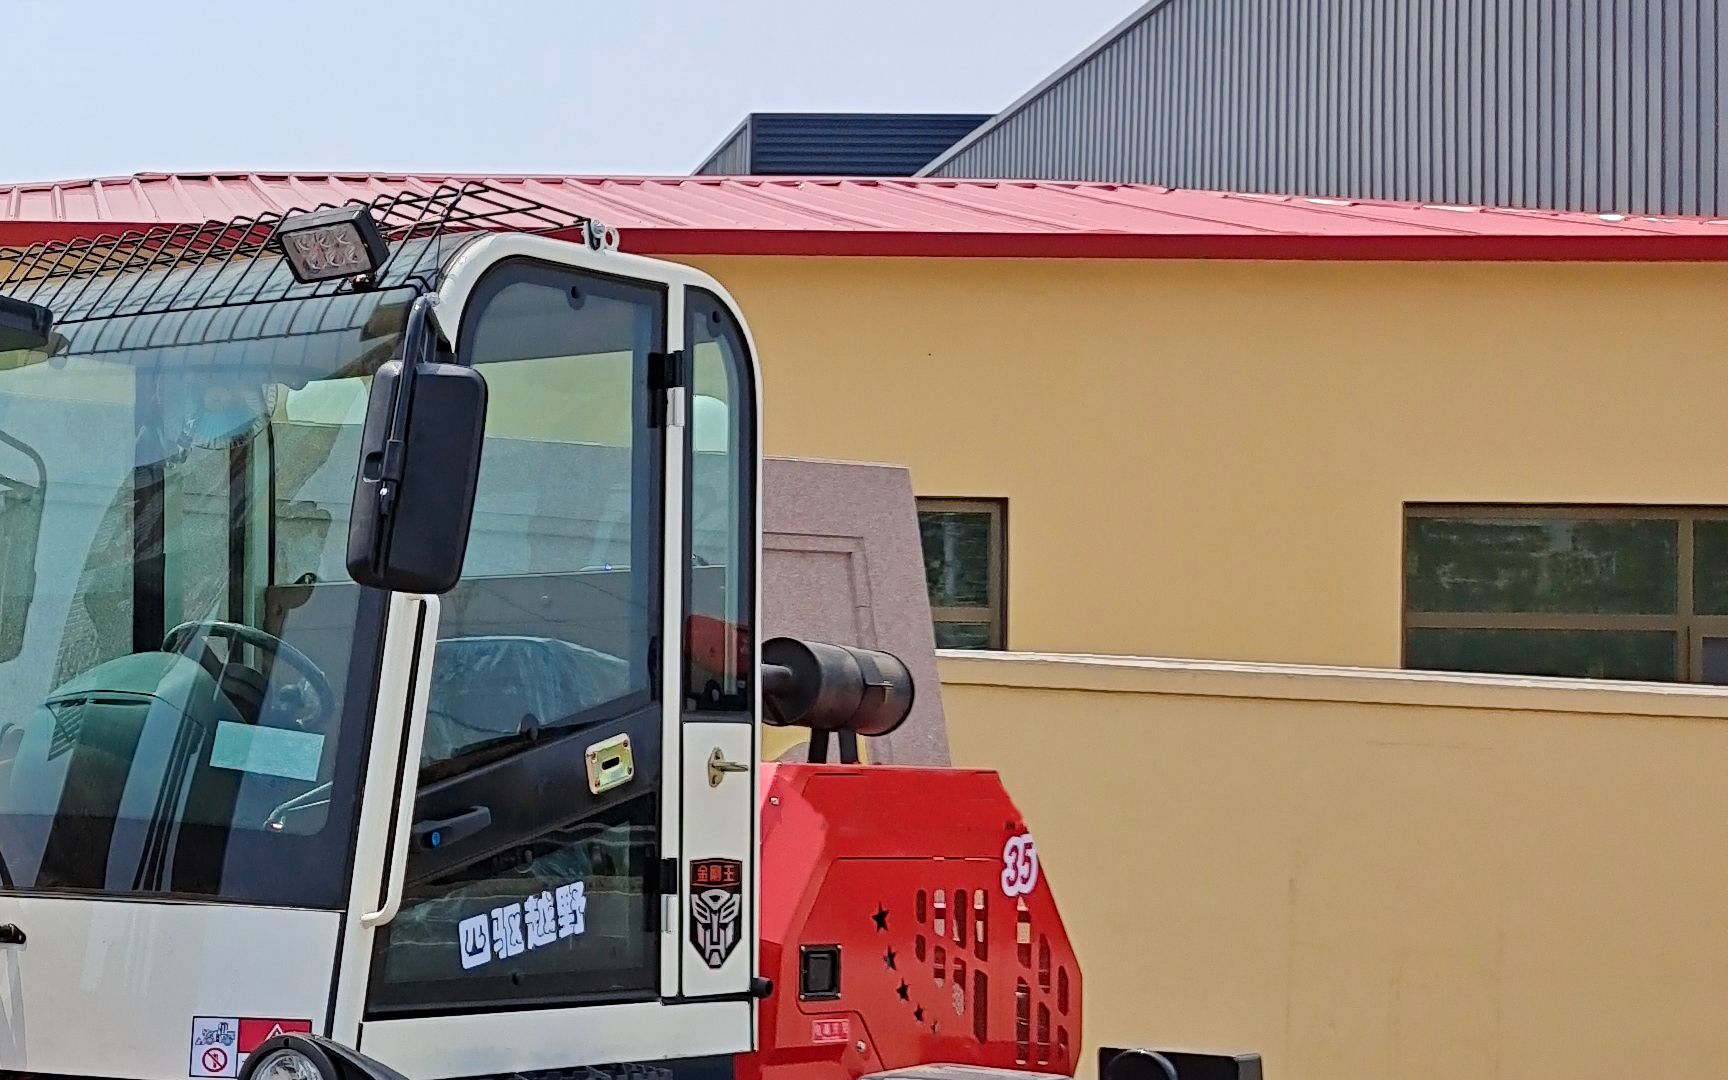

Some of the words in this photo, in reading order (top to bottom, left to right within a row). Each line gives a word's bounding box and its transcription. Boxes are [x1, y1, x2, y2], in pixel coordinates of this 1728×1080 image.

[1004, 840, 1034, 889] 35
[458, 880, 587, 970] 四驱越野
